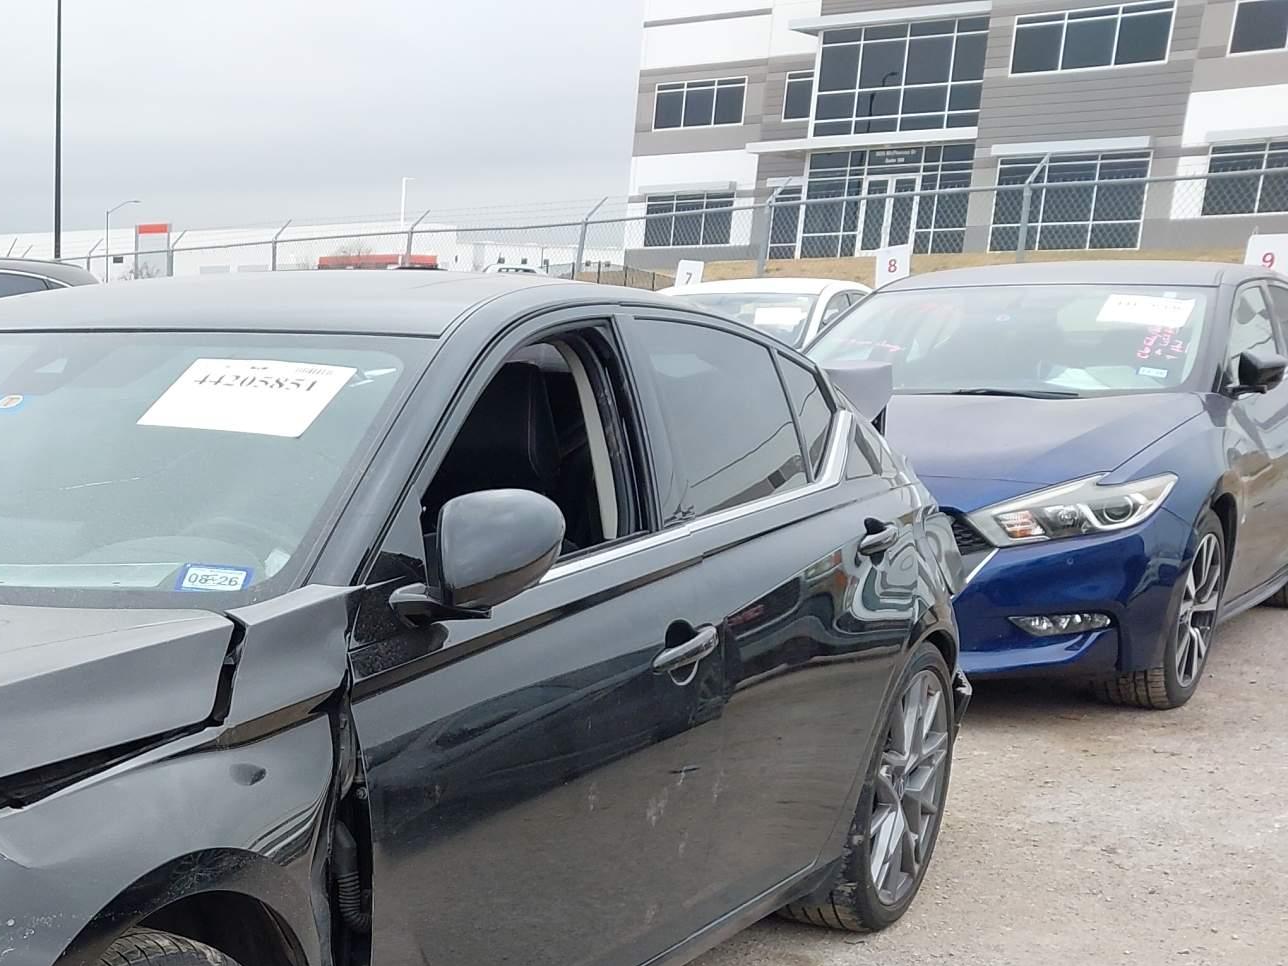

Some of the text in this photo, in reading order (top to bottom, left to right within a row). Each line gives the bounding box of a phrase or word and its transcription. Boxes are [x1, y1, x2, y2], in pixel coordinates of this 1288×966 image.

[887, 259, 897, 273] 8
[1262, 252, 1275, 268] 9
[685, 272, 692, 285] 7
[193, 374, 318, 391] 44205851
